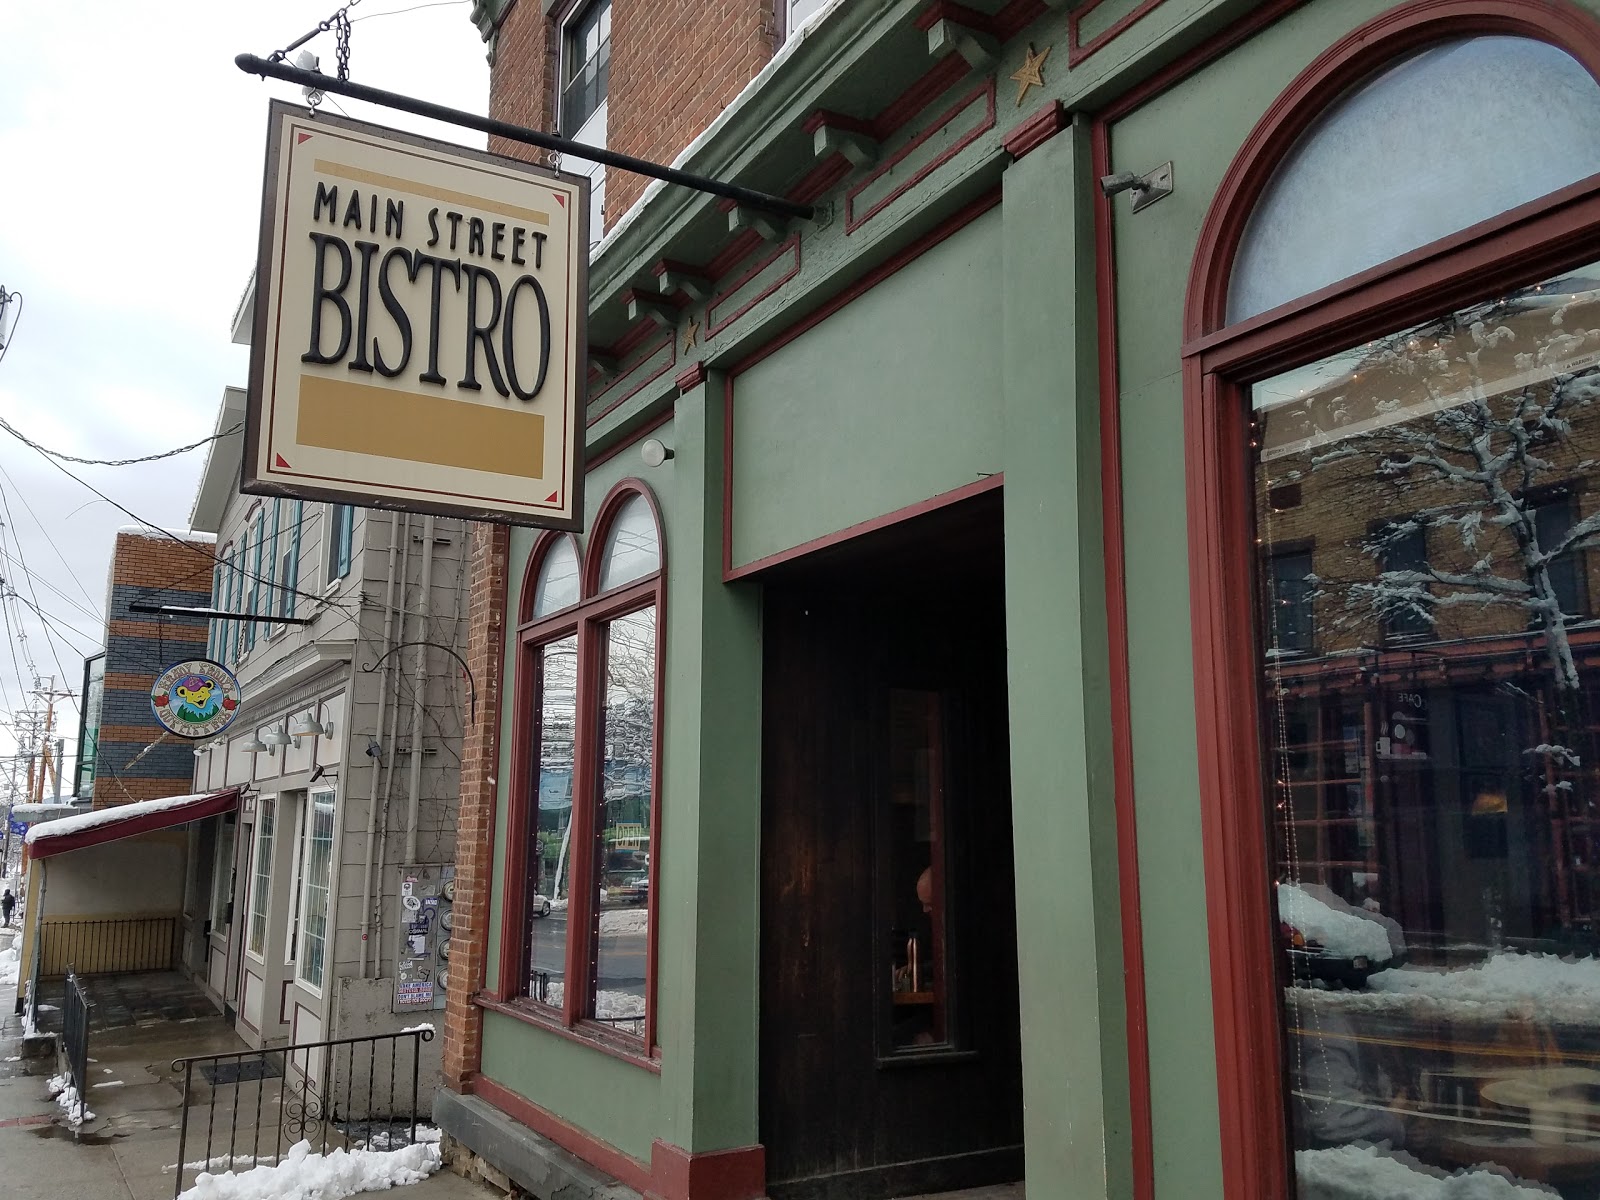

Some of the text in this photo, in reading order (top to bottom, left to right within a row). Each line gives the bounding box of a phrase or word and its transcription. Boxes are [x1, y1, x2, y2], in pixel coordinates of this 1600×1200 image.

[313, 181, 548, 269] MAIN STREET
[300, 231, 551, 401] BISTRO
[617, 826, 640, 846] OPEN
